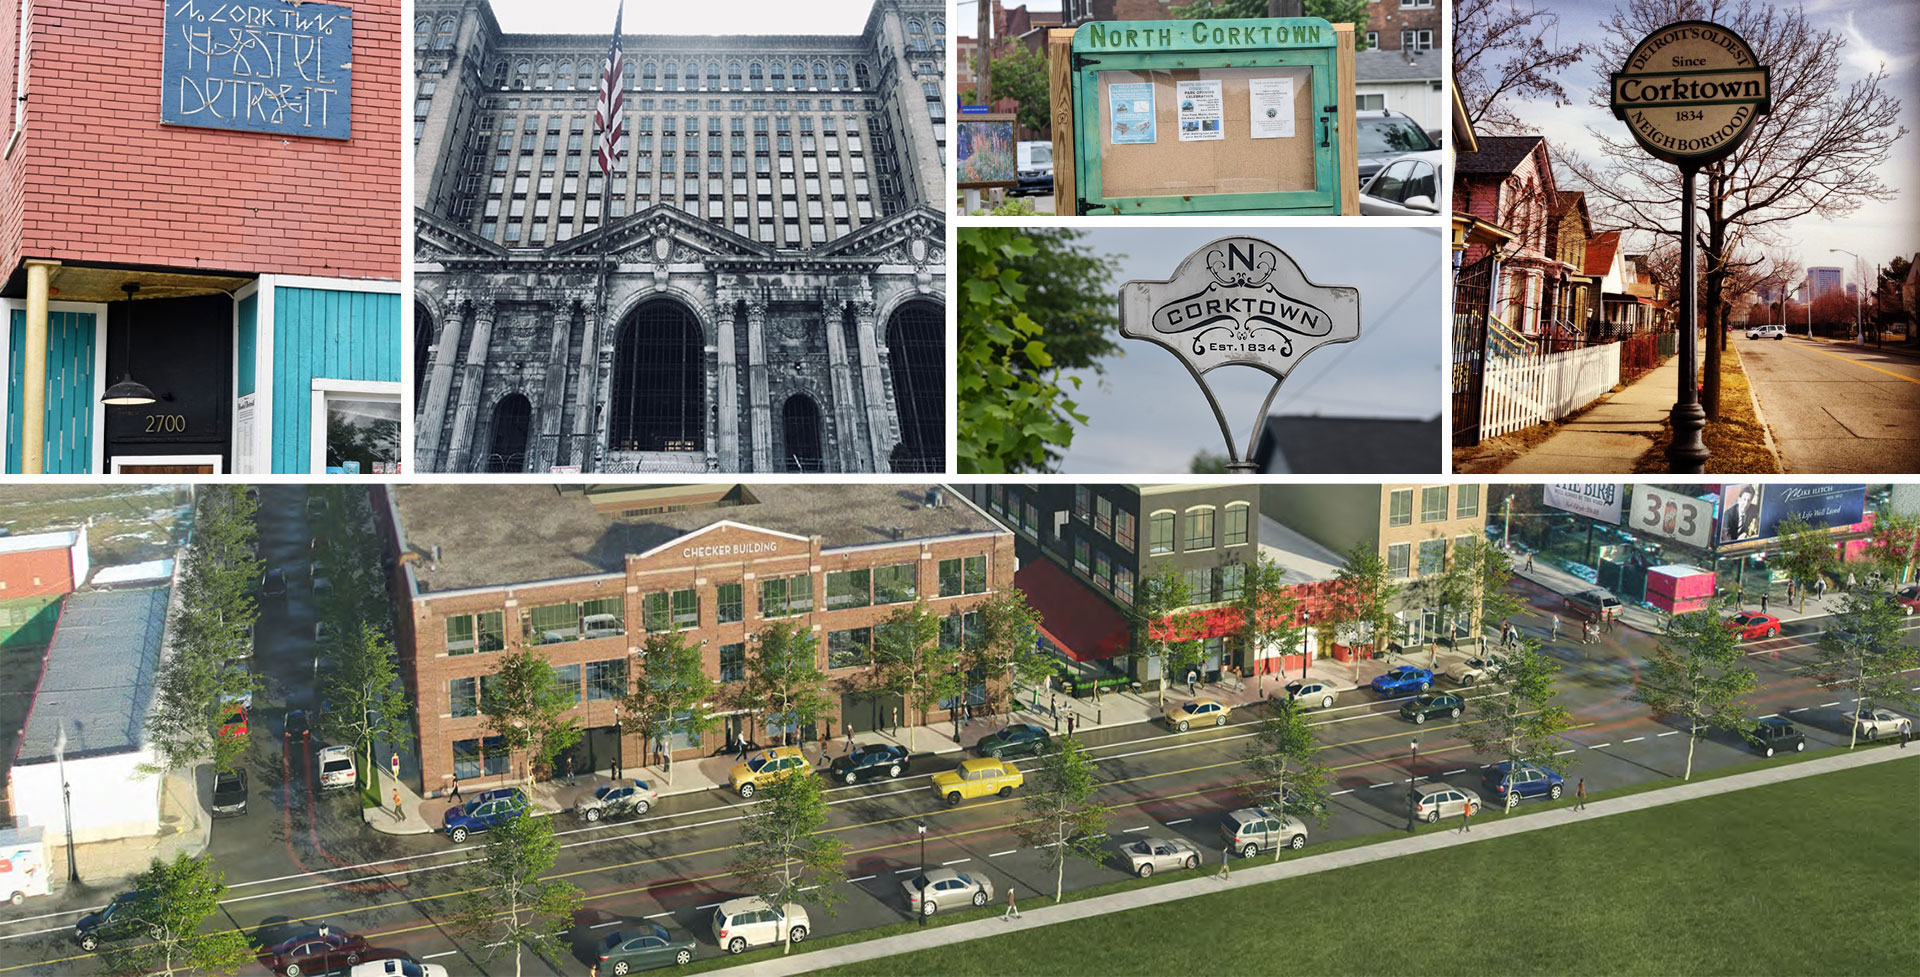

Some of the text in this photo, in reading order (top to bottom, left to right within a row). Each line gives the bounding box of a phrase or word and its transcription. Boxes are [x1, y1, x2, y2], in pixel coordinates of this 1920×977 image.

[1090, 21, 1320, 48] NORTH CORKTOWN
[182, 24, 335, 84] HOSTEL
[1632, 28, 1750, 70] DETROIT'S OLDEST
[1672, 56, 1706, 67] Since
[180, 75, 337, 128] DETROIT
[1620, 78, 1761, 102] Corktown
[1675, 110, 1703, 121] 1834
[1631, 106, 1749, 151] NEIGHBORHOOD
[1228, 243, 1254, 271] N
[1166, 298, 1319, 329] CORKTOWN
[145, 414, 186, 432] 2700
[1584, 483, 1615, 506] BIRD
[1801, 511, 1813, 521] Life
[1814, 508, 1825, 517] Well
[1826, 505, 1842, 515] Lived
[683, 542, 777, 558] CHECKER BUILDING
